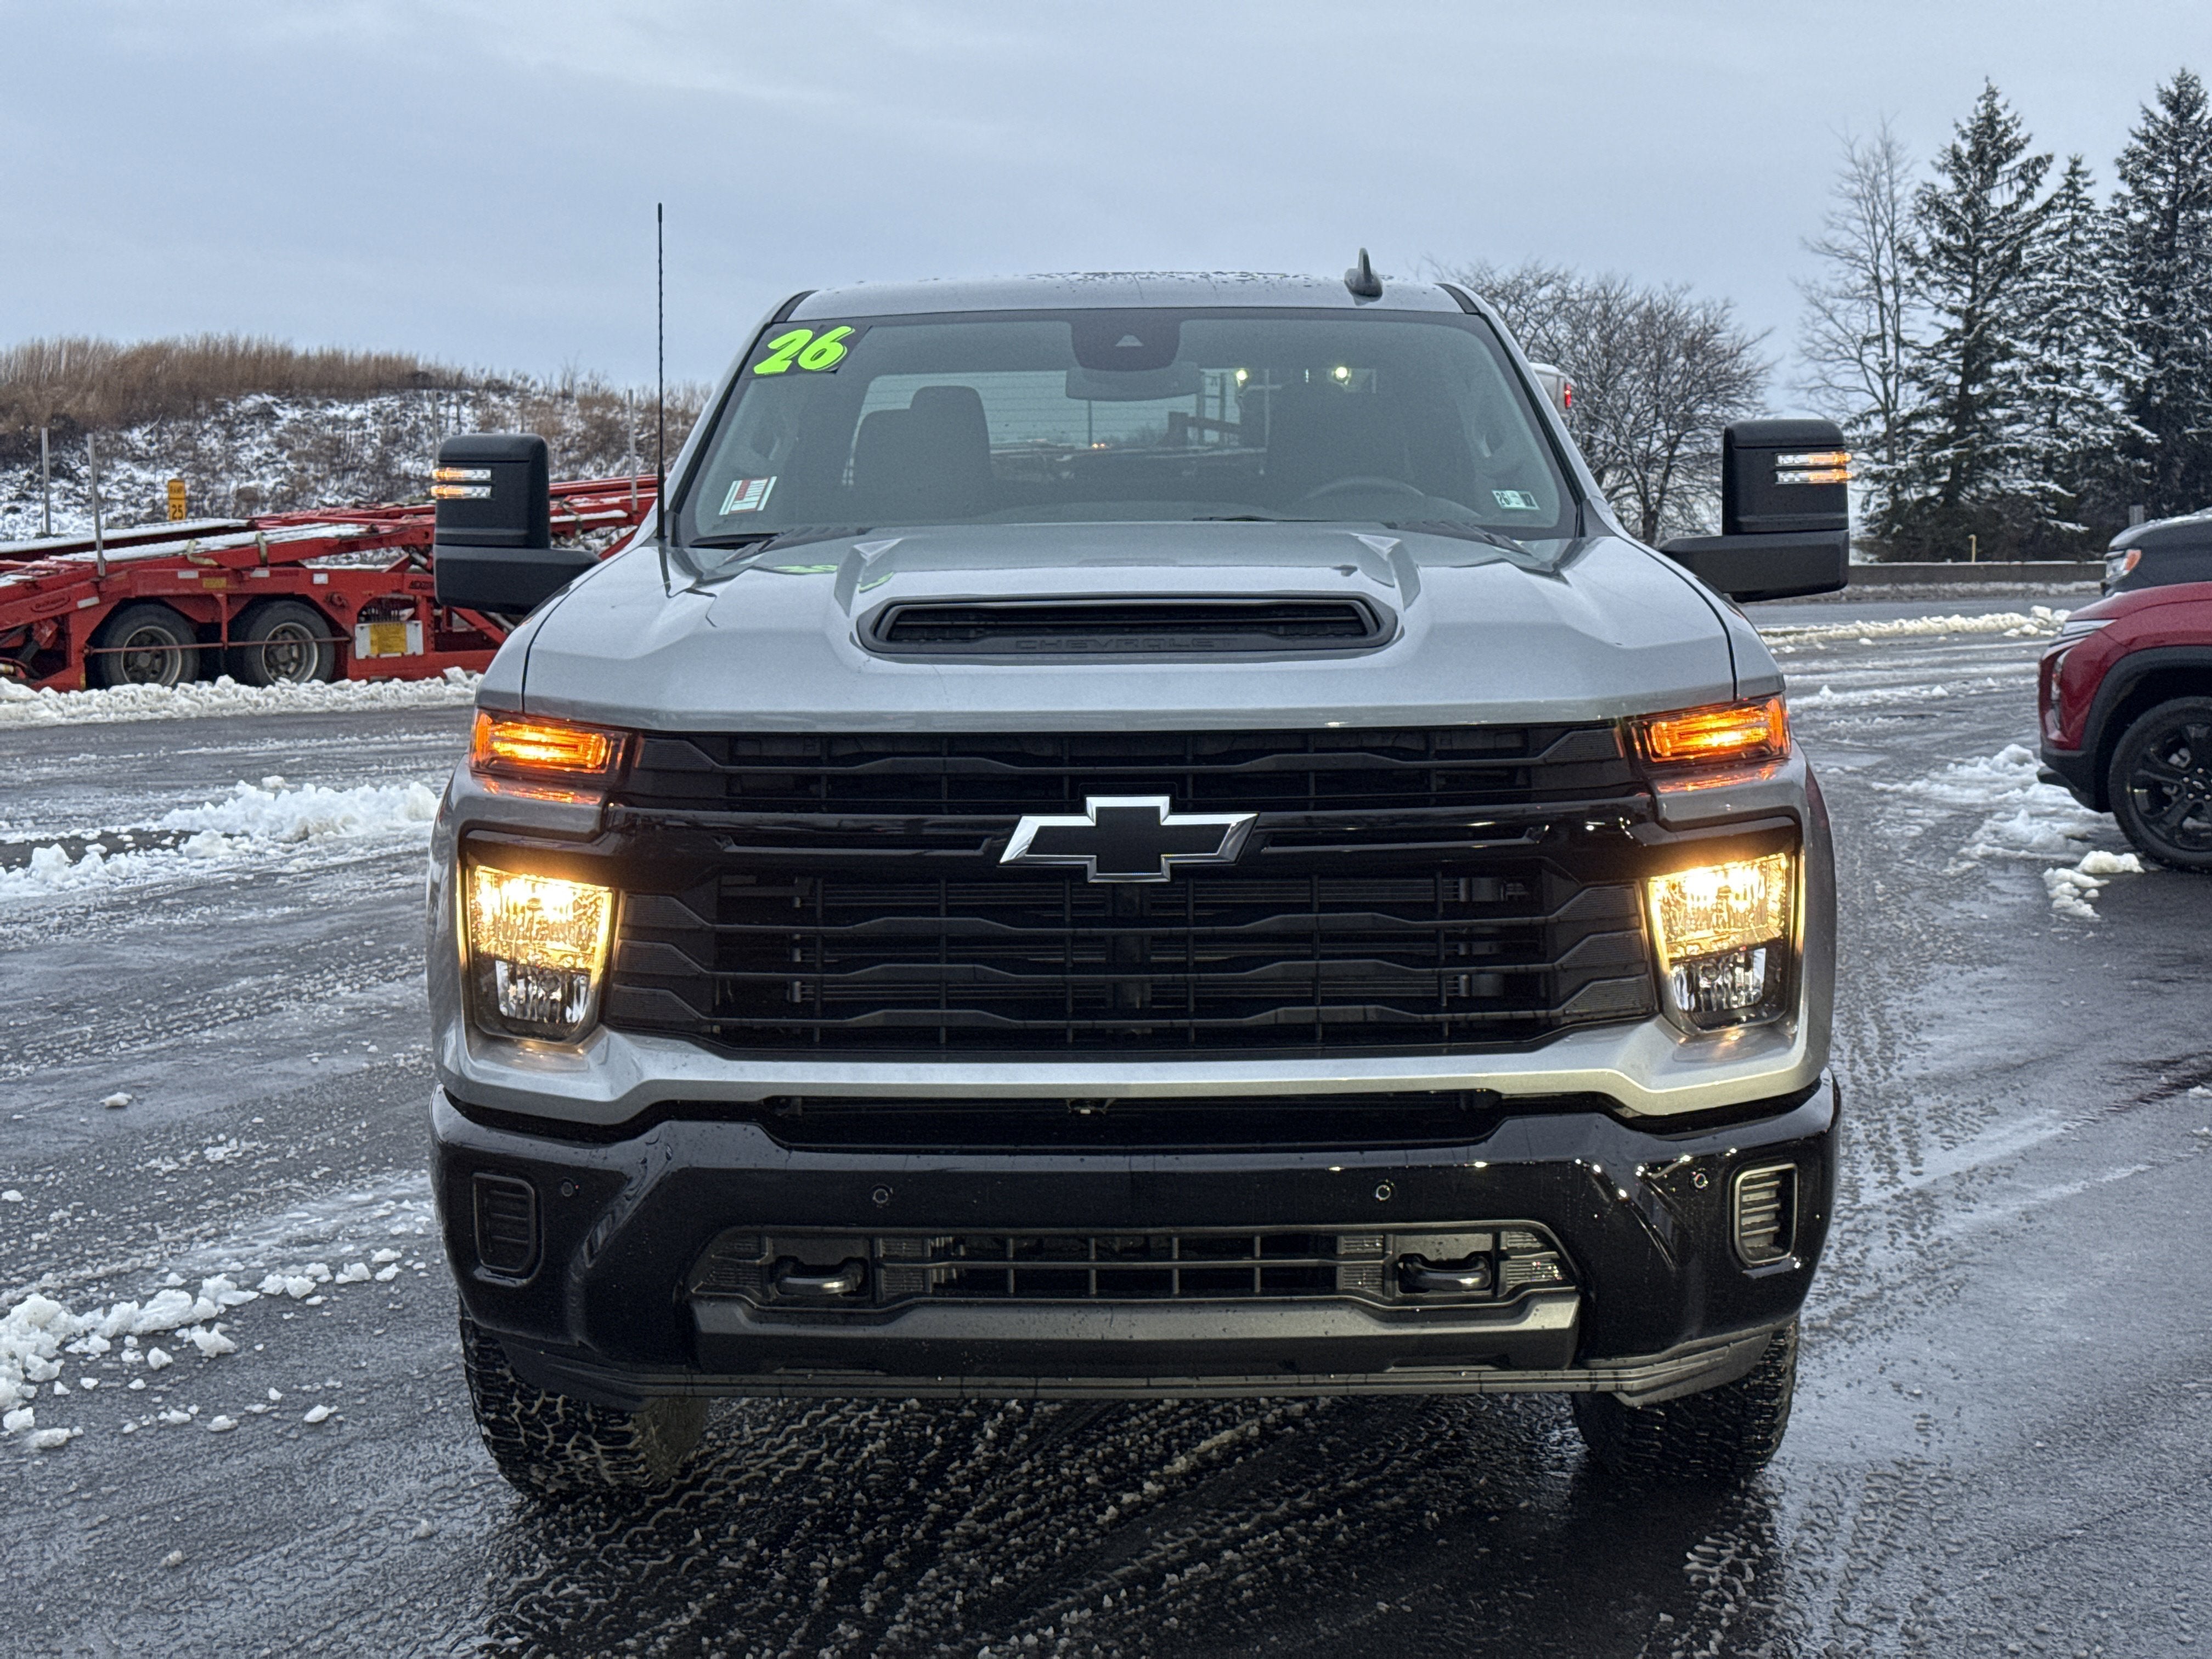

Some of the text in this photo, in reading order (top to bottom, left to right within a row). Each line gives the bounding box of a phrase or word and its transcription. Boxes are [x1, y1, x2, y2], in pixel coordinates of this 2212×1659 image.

[754, 326, 855, 375] 26
[1495, 492, 1510, 505] 26
[171, 504, 183, 521] 25
[1016, 638, 1239, 650] CHEVROLET
